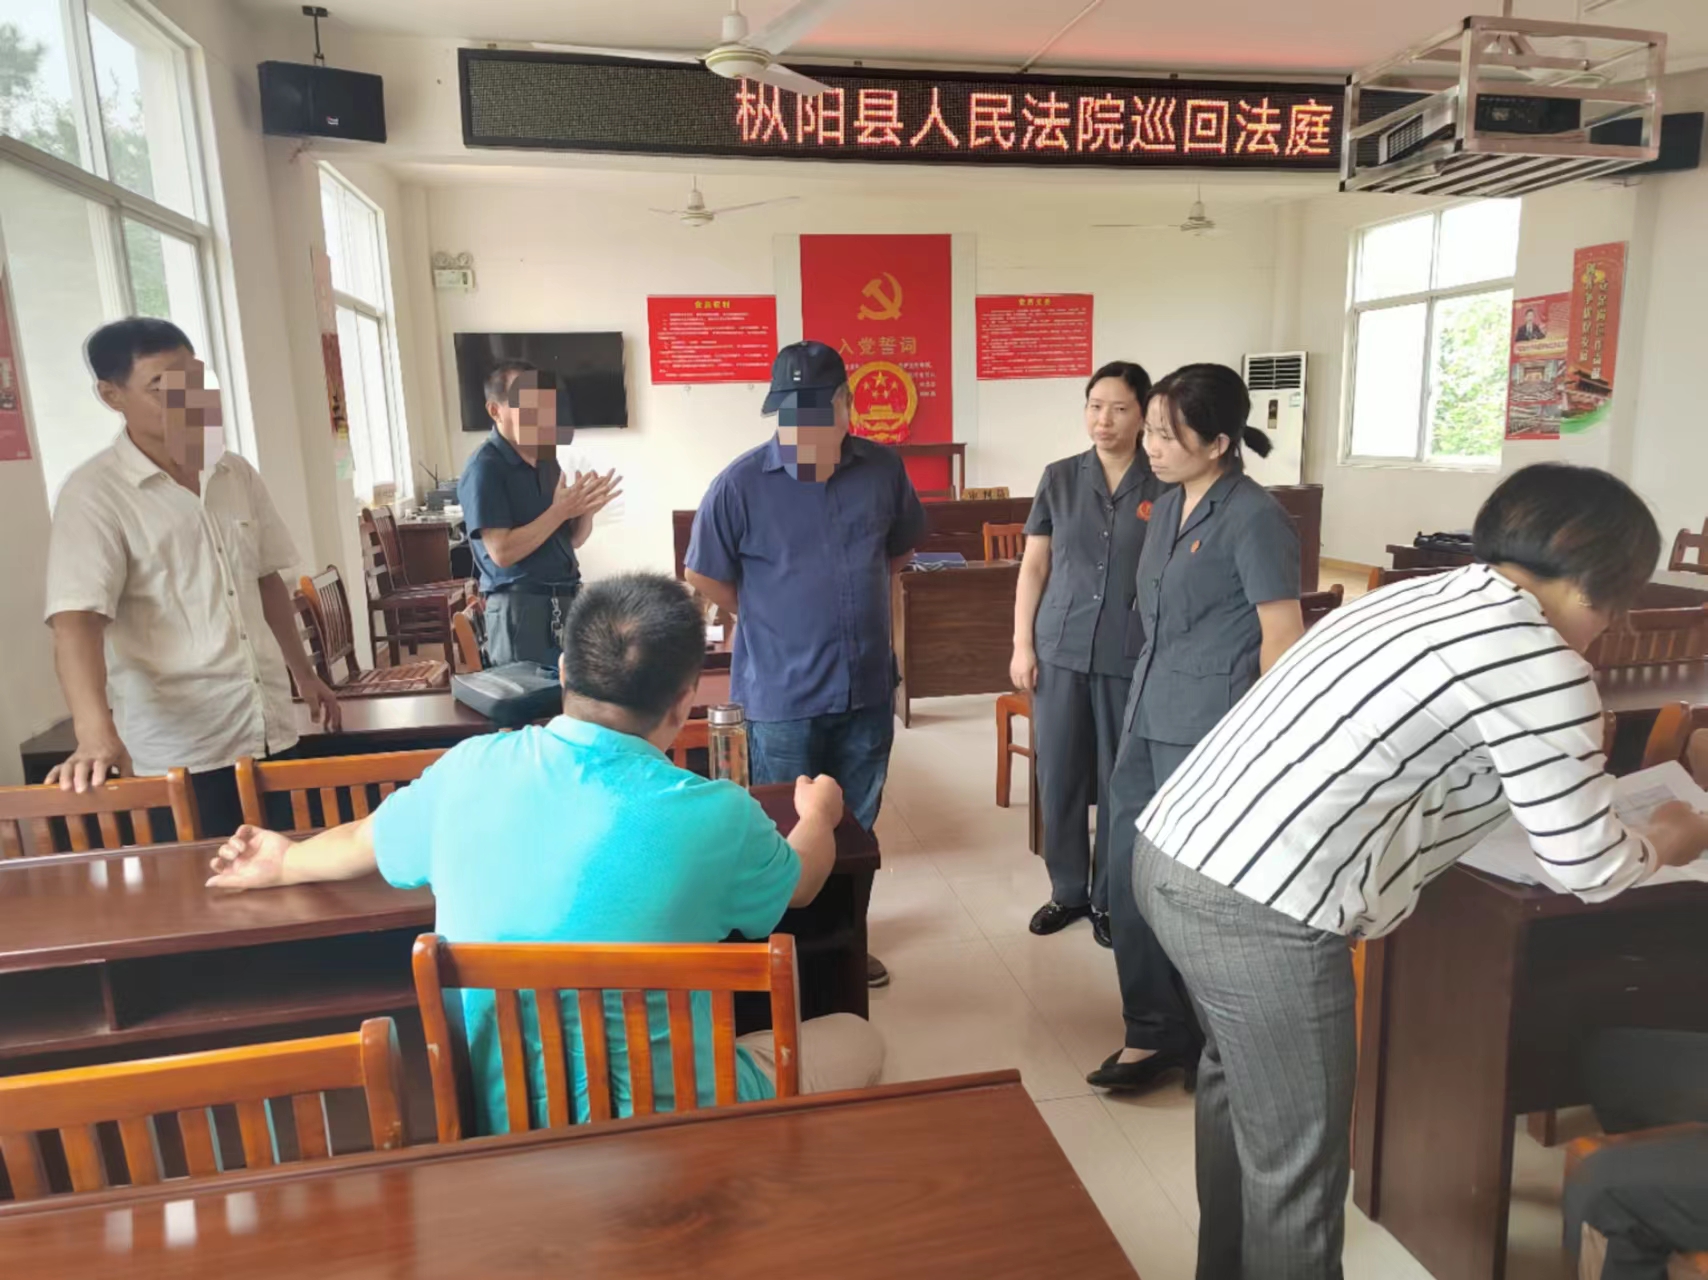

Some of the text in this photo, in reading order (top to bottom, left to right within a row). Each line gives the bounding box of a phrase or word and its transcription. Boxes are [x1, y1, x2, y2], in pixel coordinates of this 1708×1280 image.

[735, 78, 1334, 156] 枞阳县人民法院巡回法庭
[839, 336, 917, 355] 入党誓词
